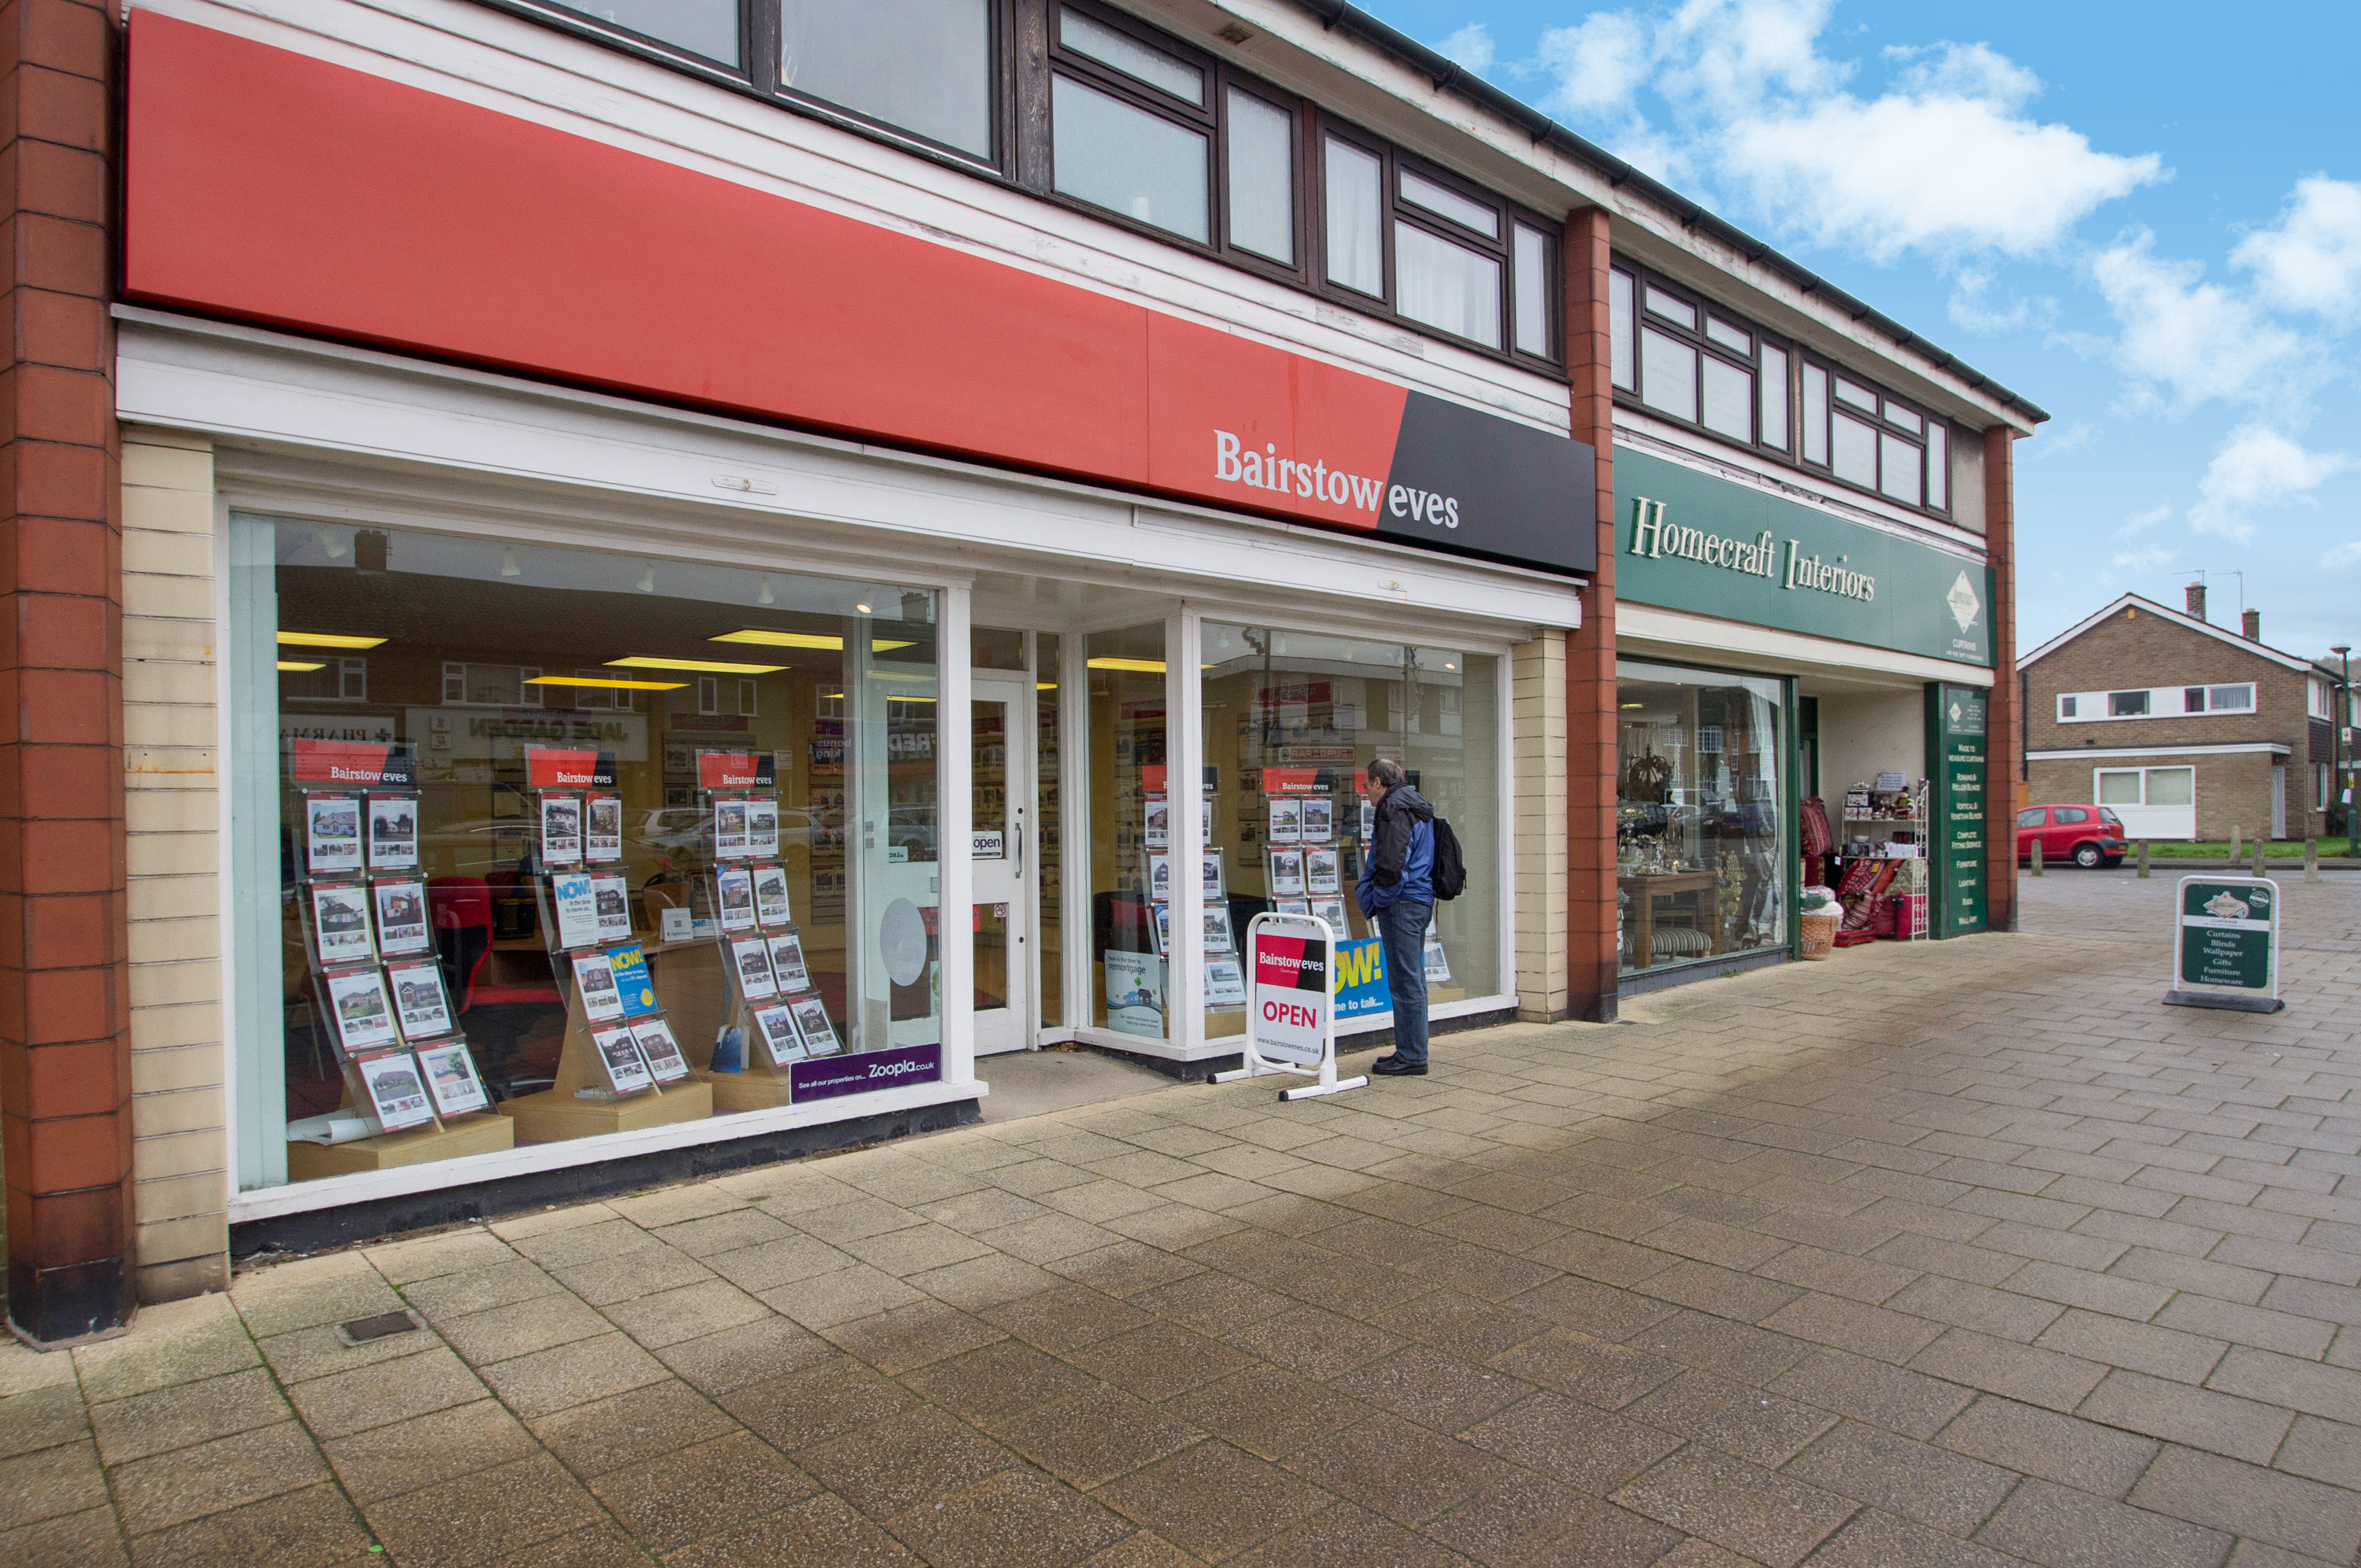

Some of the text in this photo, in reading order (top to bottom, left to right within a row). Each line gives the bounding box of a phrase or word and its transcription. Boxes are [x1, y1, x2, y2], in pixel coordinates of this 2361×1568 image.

[1214, 429, 1459, 529] Bairstow eves
[1631, 496, 1875, 601] Homecraft Interiors
[331, 766, 408, 782] Bairstow eves
[557, 772, 611, 784] Bairstow eves
[722, 774, 756, 784] Bairstow
[1283, 781, 1328, 791] Bairstow eves
[974, 839, 1000, 850] open
[556, 879, 592, 901] NOW!
[2207, 930, 2241, 939] Curtains
[2211, 939, 2236, 948] Blinds
[2204, 946, 2243, 957] Wallpaper
[610, 949, 644, 972] NOW!
[1259, 951, 1325, 972] Bairstow eves
[2212, 957, 2232, 966] Gifts
[1108, 962, 1146, 975] remortgage
[2204, 966, 2241, 976] Furniture
[2200, 976, 2243, 986] Homeware
[1348, 1000, 1358, 1010] to
[1361, 996, 1384, 1009] talk...
[1263, 1001, 1317, 1029] OPEN
[1257, 1037, 1320, 1055] www.bairstoweves.co.uk
[827, 1075, 854, 1087] properties
[869, 1060, 934, 1078] Zoopla.co.uk
